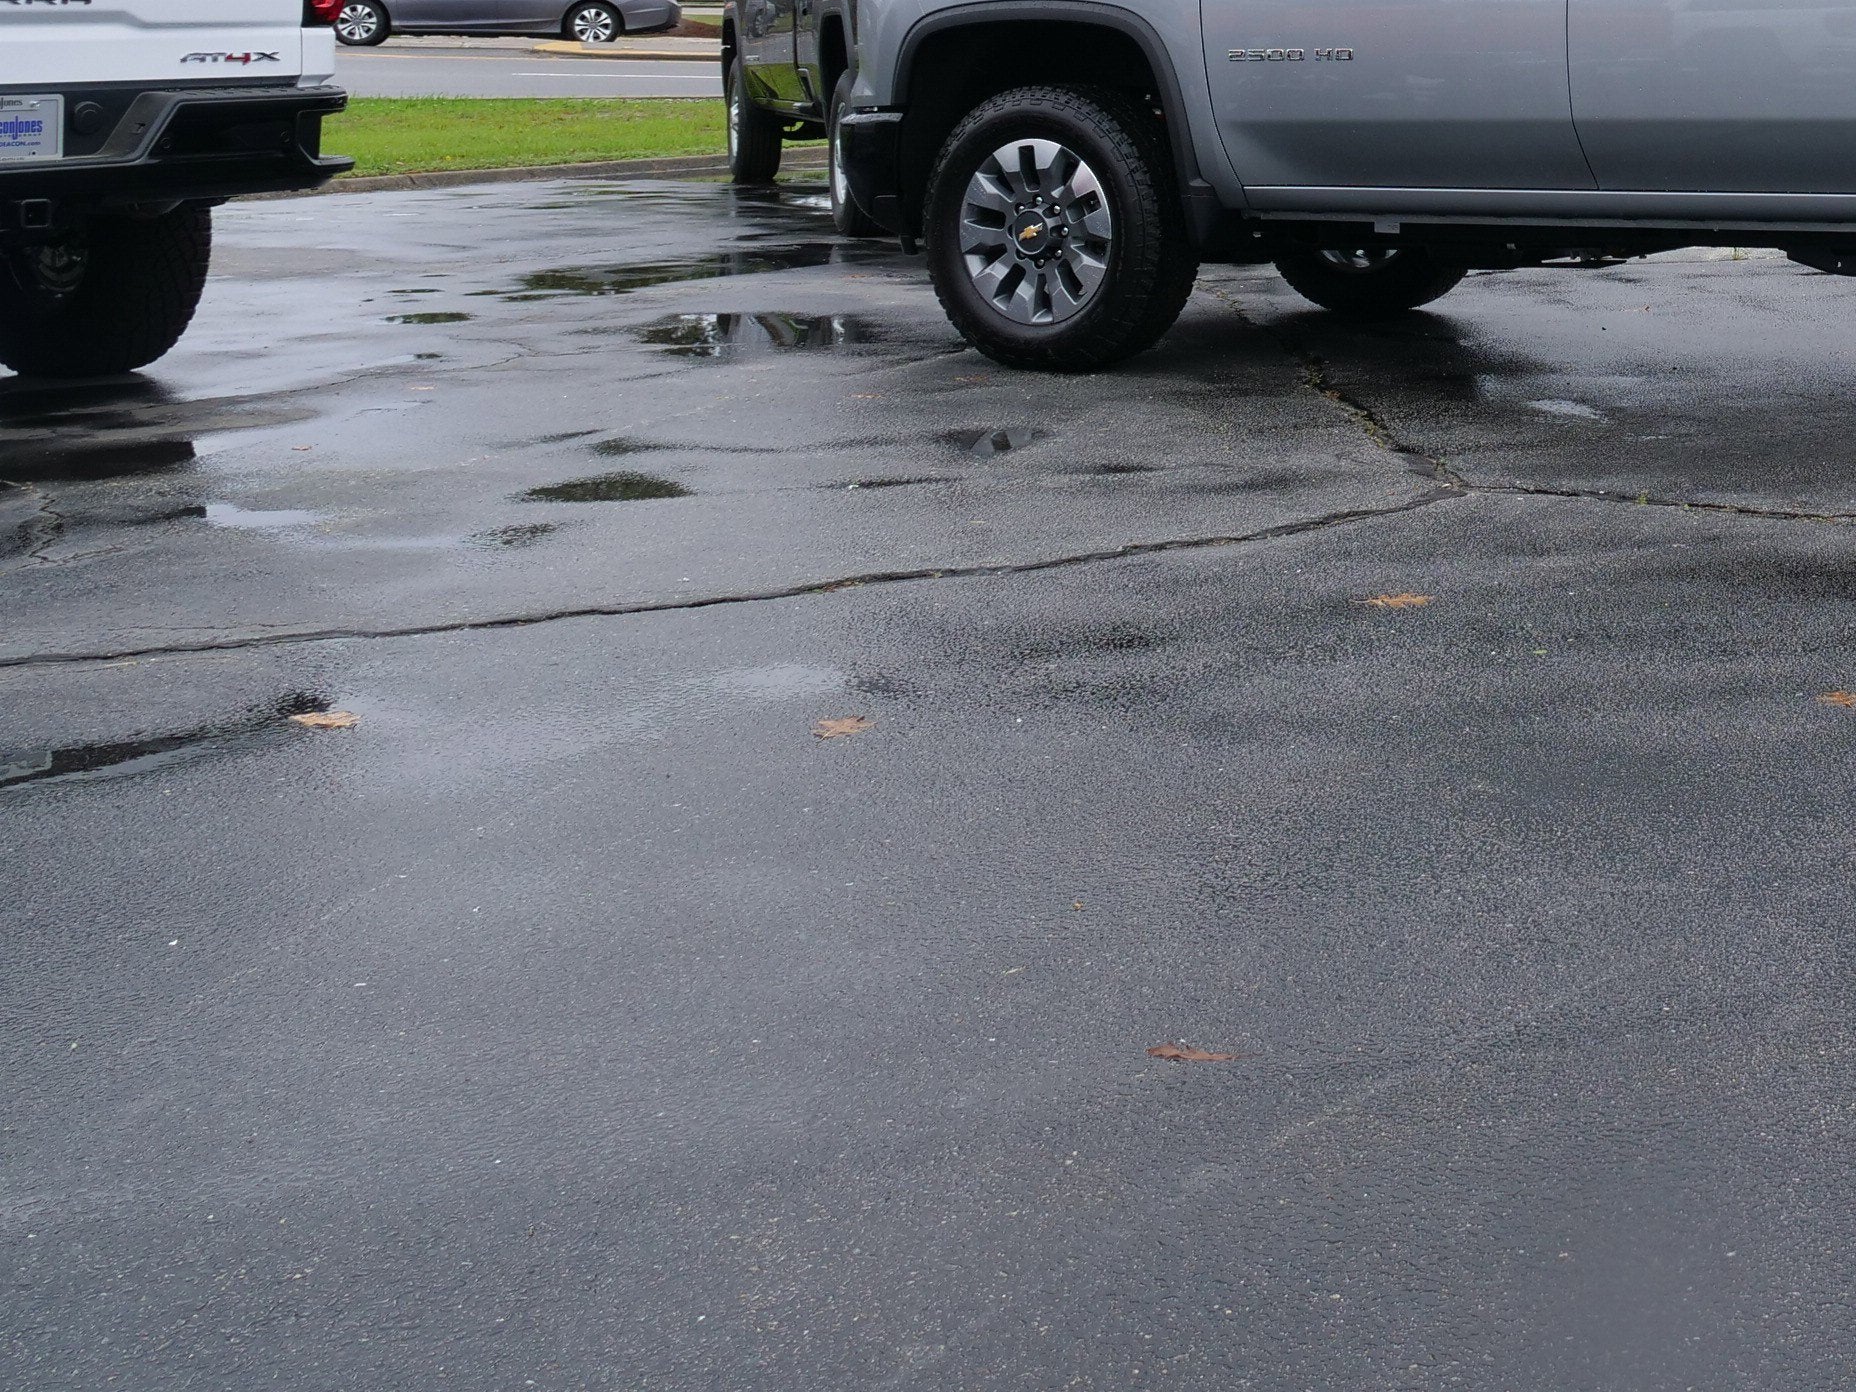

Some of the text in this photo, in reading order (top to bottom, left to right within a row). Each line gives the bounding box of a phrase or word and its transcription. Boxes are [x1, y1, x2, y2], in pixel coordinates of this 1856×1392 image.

[180, 52, 281, 65] AT4X
[1228, 49, 1353, 61] 2500 HD
